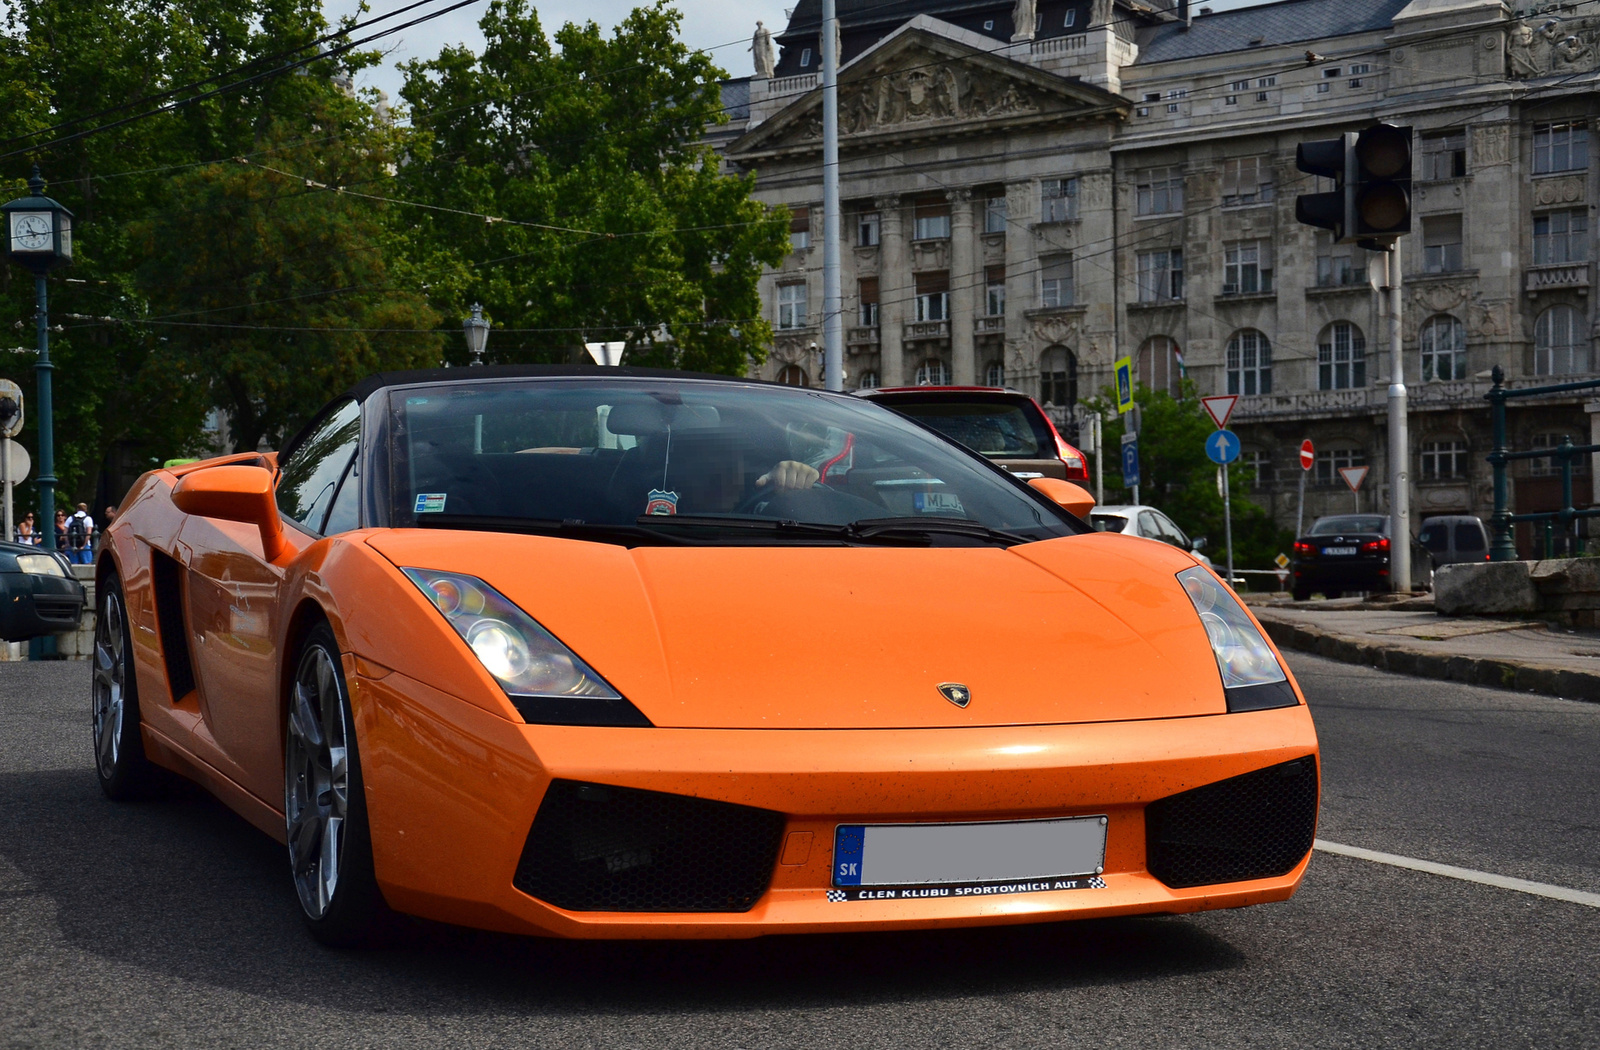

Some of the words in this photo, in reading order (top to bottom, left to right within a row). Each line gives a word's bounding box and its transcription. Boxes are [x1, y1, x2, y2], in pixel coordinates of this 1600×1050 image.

[1126, 450, 1134, 472] P
[840, 862, 858, 876] SK
[902, 888, 949, 898] KLUBU
[1054, 880, 1078, 889] AUT
